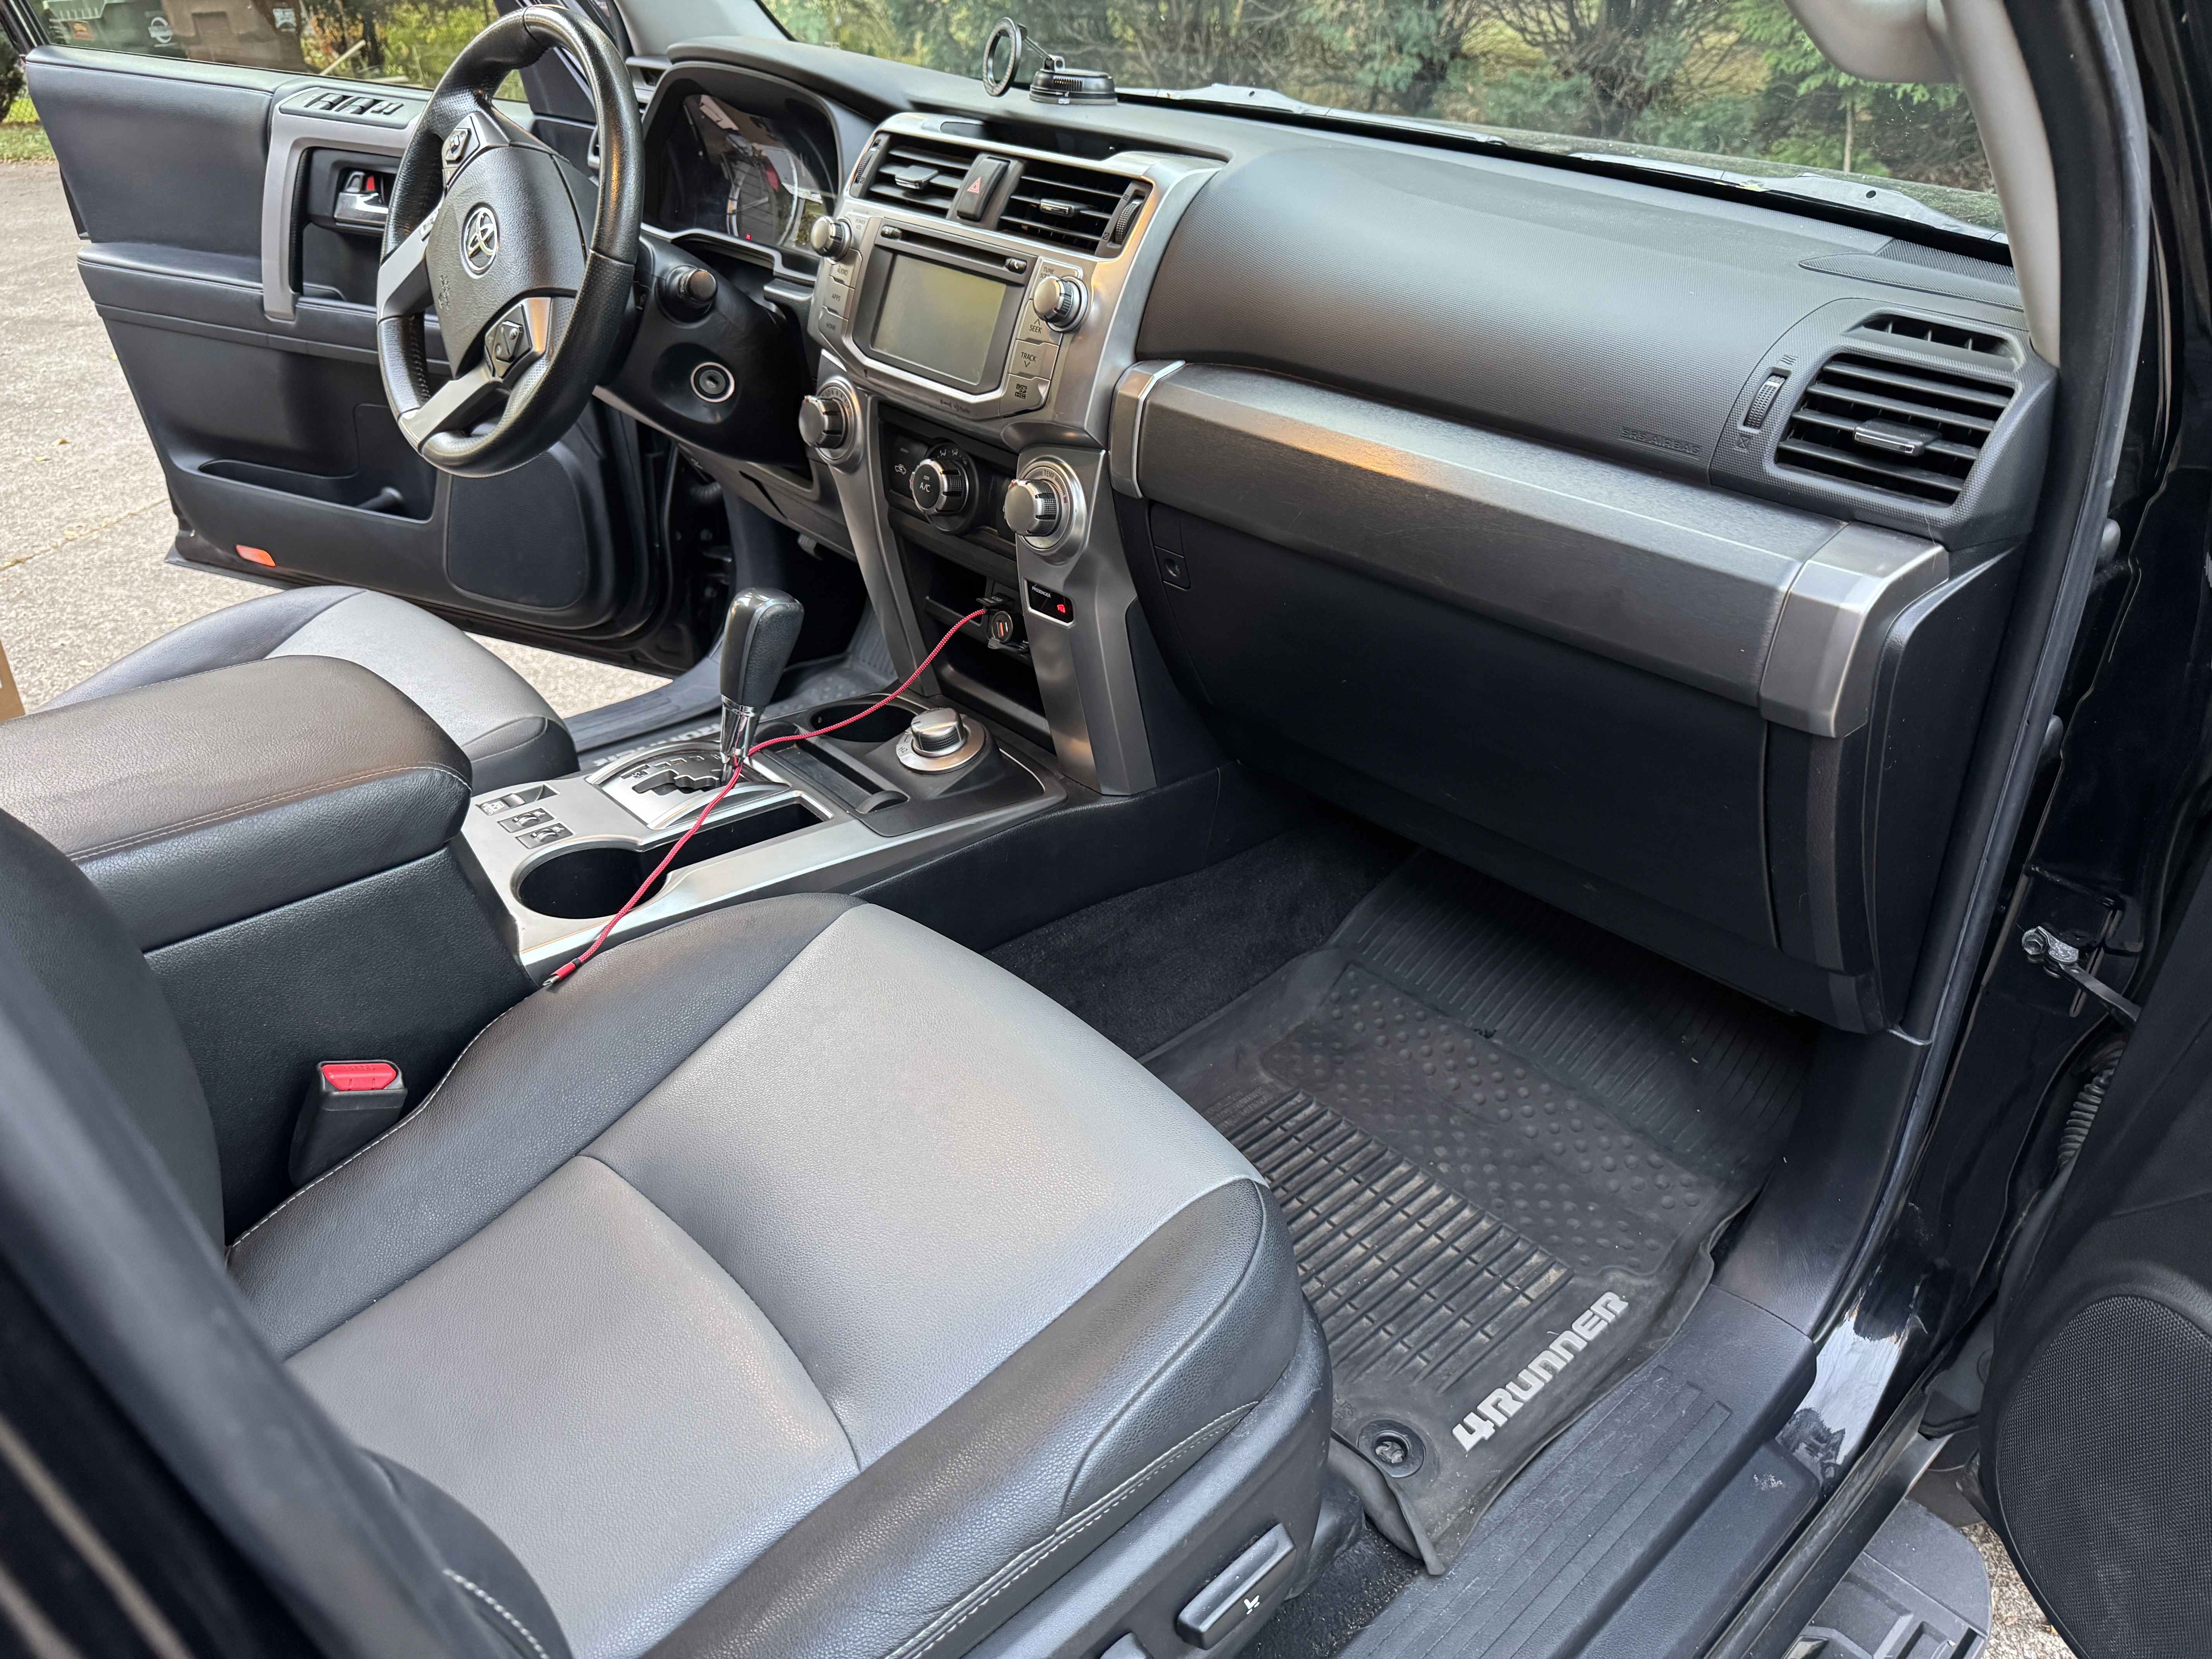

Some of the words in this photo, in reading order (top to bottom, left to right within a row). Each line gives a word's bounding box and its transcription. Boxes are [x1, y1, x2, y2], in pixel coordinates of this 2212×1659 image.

[832, 294, 841, 302] APPS
[1029, 325, 1042, 333] SEEK
[1021, 352, 1037, 362] TRACK
[1044, 469, 1055, 479] TEMP
[919, 482, 930, 492] A/C
[483, 807, 494, 816] AUTO
[1451, 1291, 1629, 1451] 4RUNNER
